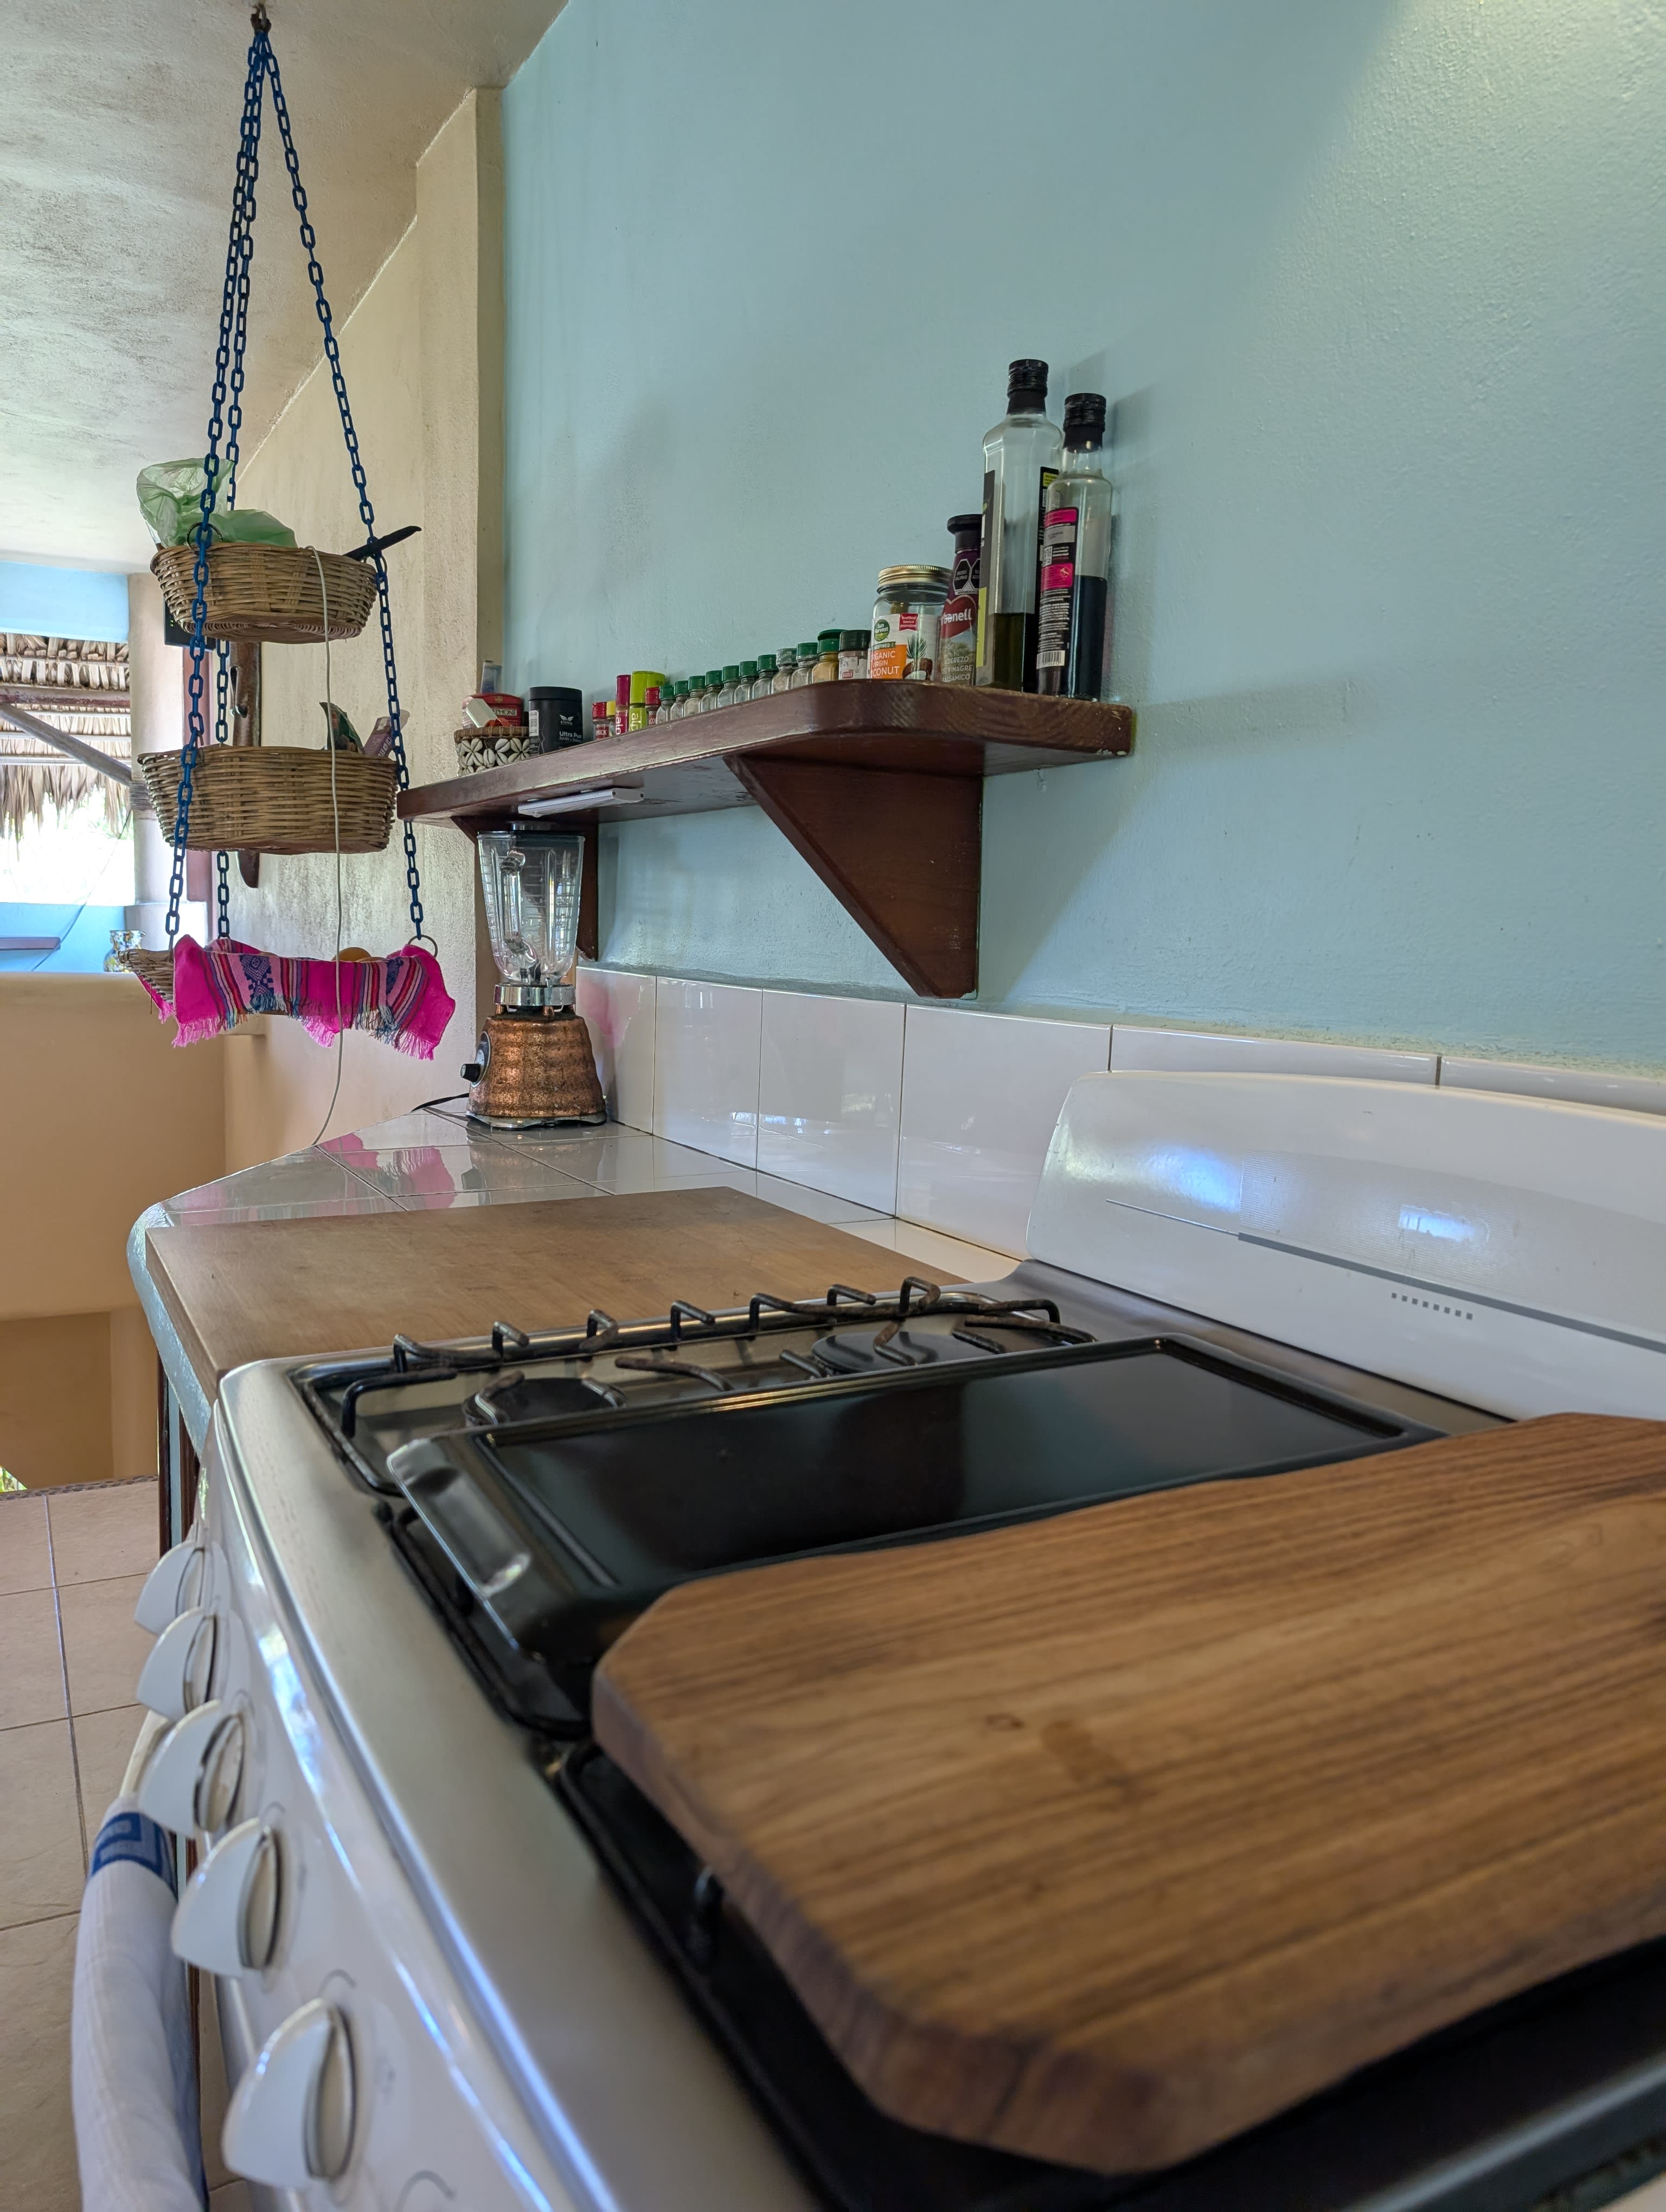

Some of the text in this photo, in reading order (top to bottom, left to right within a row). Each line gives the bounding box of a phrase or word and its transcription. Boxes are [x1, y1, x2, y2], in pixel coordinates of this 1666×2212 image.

[941, 608, 972, 625] rbonell
[872, 651, 896, 660] RGANIC
[870, 666, 900, 677] CONUT
